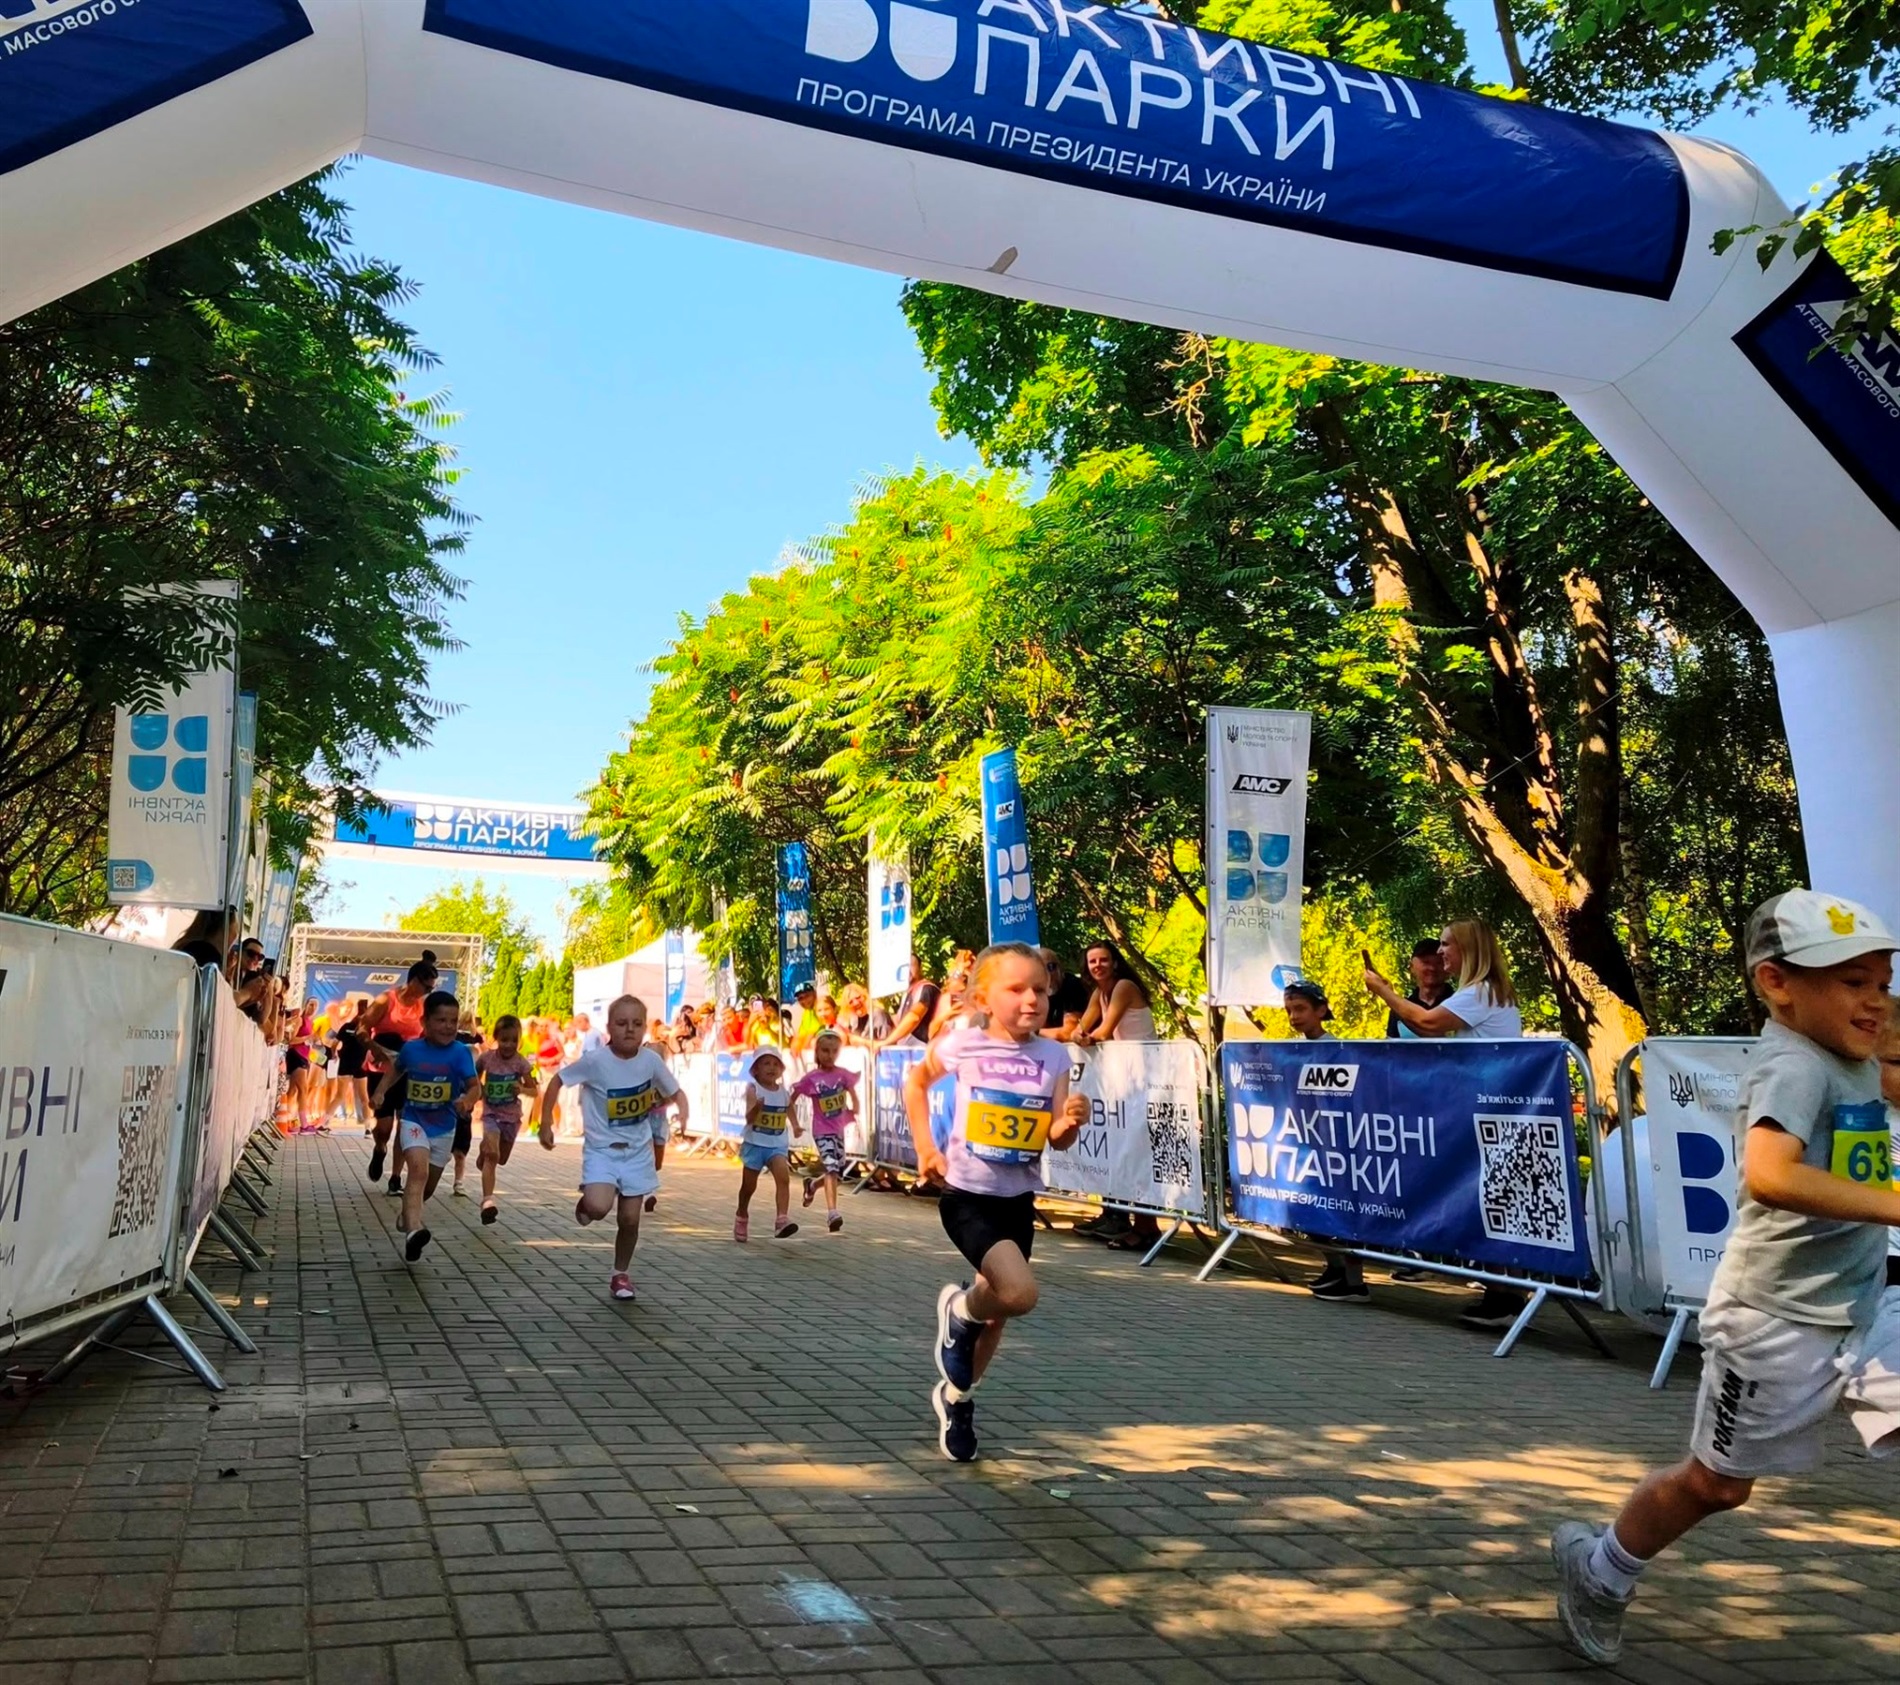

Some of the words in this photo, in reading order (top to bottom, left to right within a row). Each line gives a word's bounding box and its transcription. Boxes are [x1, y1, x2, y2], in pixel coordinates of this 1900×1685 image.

[4, 0, 116, 55] МАСОВОГО
[974, 22, 1335, 171] ПАРКИ
[796, 77, 976, 141] ПРОГРАМА
[987, 121, 1191, 187] ПРЕЗИДЕНТА
[1201, 168, 1328, 214] УКРАЇНИ
[1841, 354, 1900, 418] МАСОВОГО
[454, 824, 549, 848] ПАРКИ
[411, 1083, 444, 1100] 539
[1304, 1067, 1350, 1088] АМС
[616, 1094, 646, 1116] 501
[761, 1114, 781, 1128] 511
[981, 1112, 1039, 1143] 537
[1277, 1108, 1436, 1157] АКТИВНІ
[1271, 1144, 1401, 1198] ПАРКИ
[1848, 1141, 1889, 1182] 63
[1240, 1184, 1277, 1200] ПРОГРАМА
[1278, 1190, 1355, 1213] ПРЕЗИДЕНТА
[1358, 1202, 1406, 1220] УКРАЇНИ
